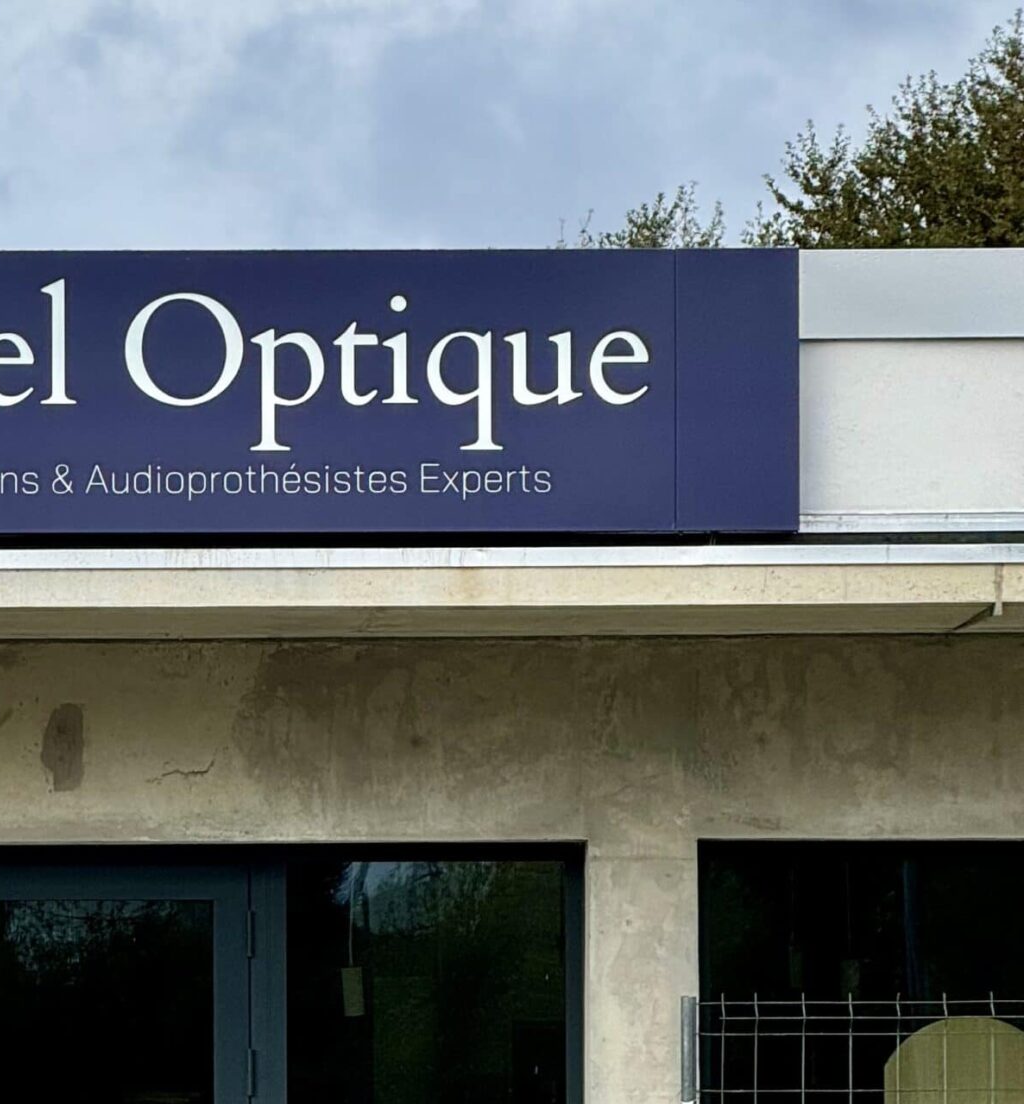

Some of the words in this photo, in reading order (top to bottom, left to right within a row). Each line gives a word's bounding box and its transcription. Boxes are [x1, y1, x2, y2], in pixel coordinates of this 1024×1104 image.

[124, 292, 650, 453] Optique
[51, 463, 75, 496] &
[85, 462, 409, 503] Audioprothésistes
[420, 462, 552, 502] Experts
